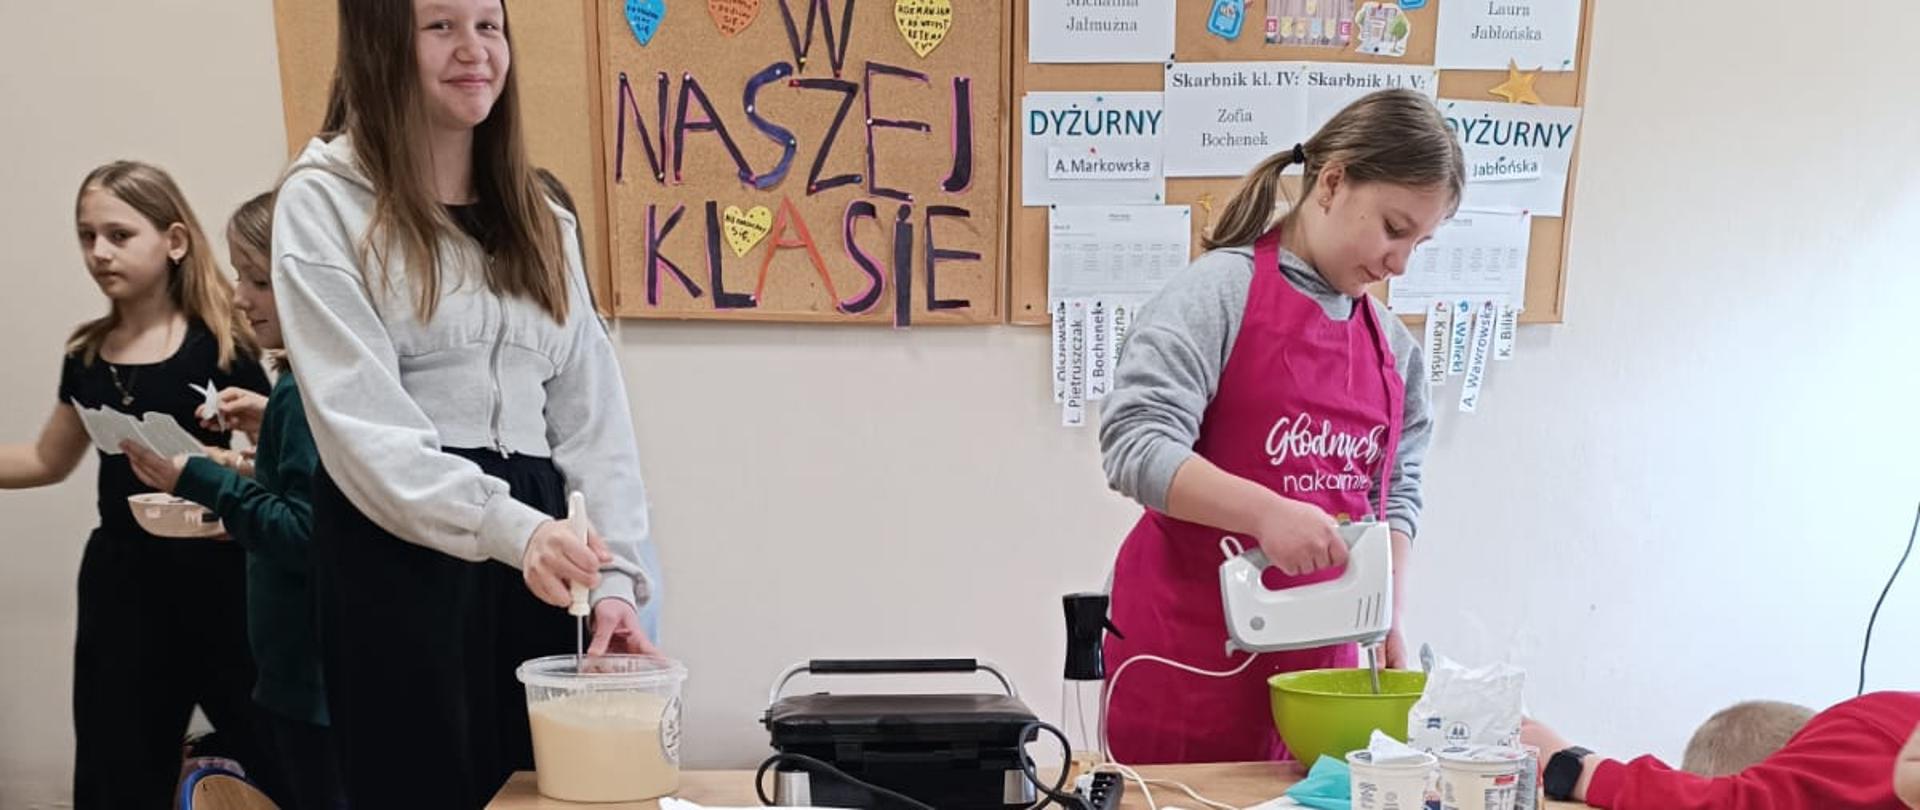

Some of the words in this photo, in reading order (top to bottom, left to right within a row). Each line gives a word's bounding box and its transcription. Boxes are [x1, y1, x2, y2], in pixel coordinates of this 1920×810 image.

[1487, 1, 1530, 17] Laura
[778, 0, 854, 78] W
[1172, 71, 1248, 88] Skarbnik
[1252, 71, 1272, 87] kl.
[1276, 71, 1300, 87] IV:
[1308, 71, 1383, 89] Skarbnik
[1410, 75, 1426, 90] V:
[1030, 104, 1163, 137] DYŻURNY
[1217, 108, 1253, 124] Zofia
[615, 61, 973, 202] NASZEJ
[1202, 132, 1269, 148] Bochenek
[1091, 307, 1105, 378] Bochenek
[1069, 319, 1082, 408] Pietruszczak
